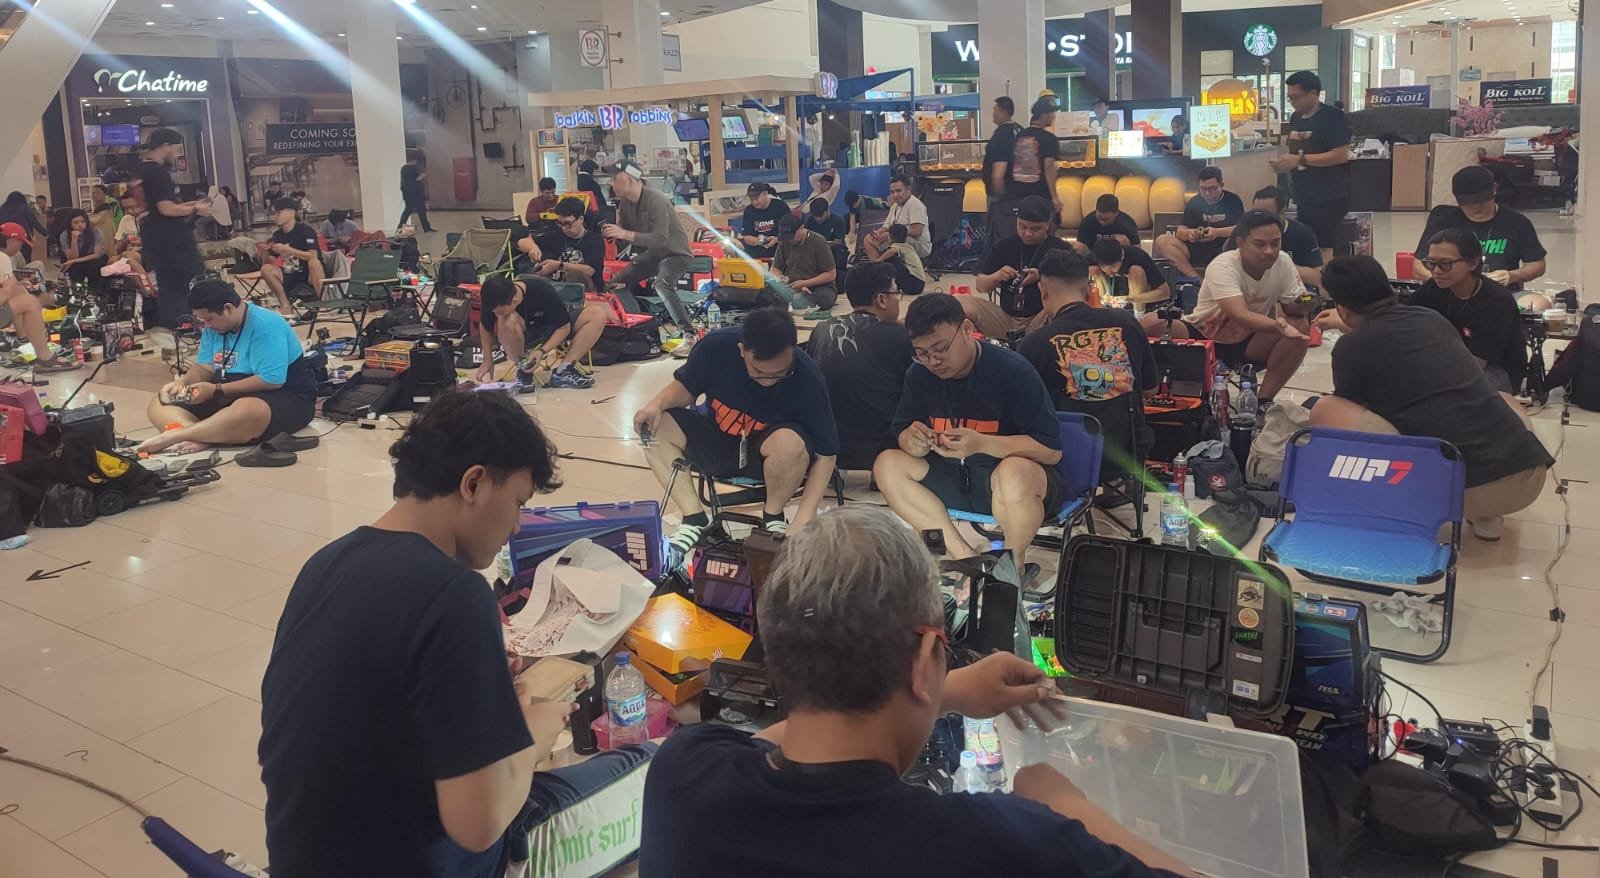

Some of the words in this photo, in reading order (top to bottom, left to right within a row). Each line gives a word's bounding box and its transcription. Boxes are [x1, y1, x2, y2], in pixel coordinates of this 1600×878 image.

[118, 69, 208, 93] Chatime
[819, 72, 838, 98] BR
[1370, 94, 1391, 104] BIG
[1395, 91, 1425, 102] KOIL
[1485, 89, 1508, 98] BIG
[1513, 86, 1546, 97] KOIL
[555, 110, 597, 128] baskin
[599, 105, 624, 129] BR
[627, 108, 673, 125] robbins
[290, 128, 339, 139] COMING
[273, 141, 321, 150] REDEFINING
[323, 140, 344, 148] YOUR
[1328, 454, 1414, 485] MP7
[705, 559, 739, 579] MP7
[622, 700, 645, 715] AQUA
[598, 799, 638, 855] surf
